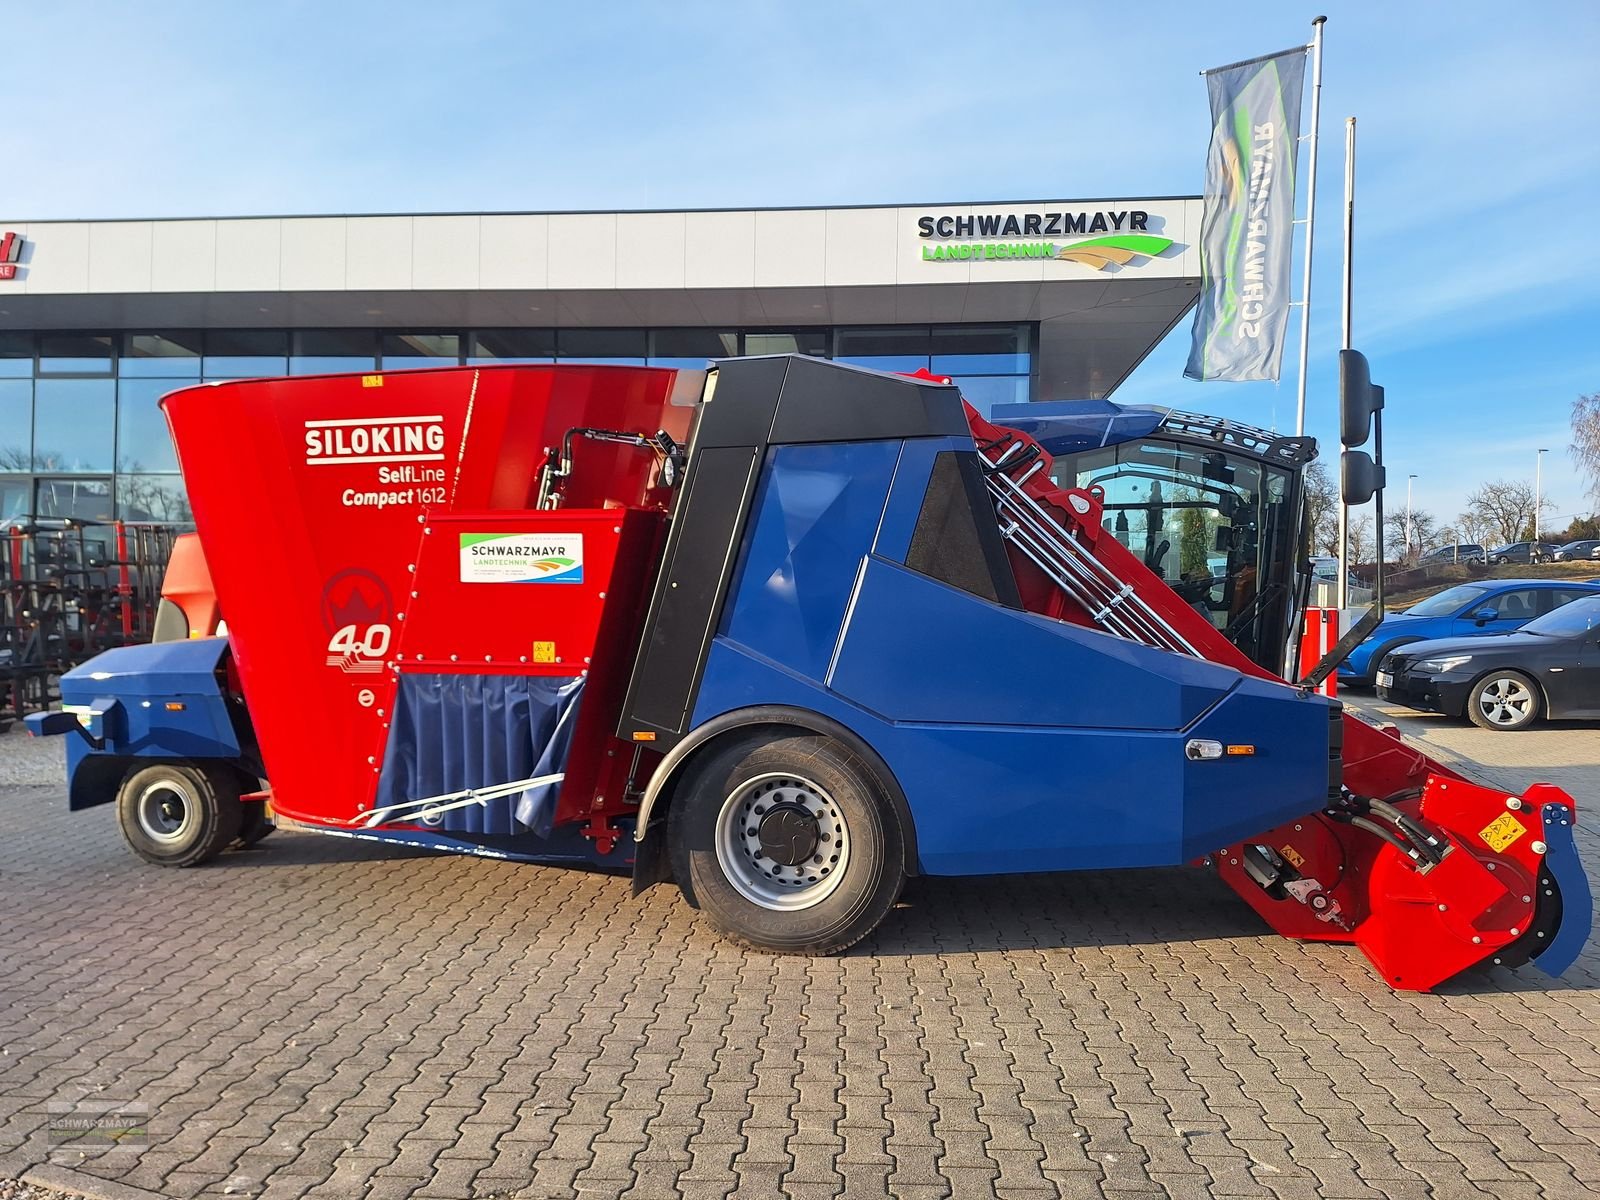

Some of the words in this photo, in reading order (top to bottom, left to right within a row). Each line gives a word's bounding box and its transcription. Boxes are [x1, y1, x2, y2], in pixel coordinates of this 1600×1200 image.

[918, 210, 1149, 238] SCHWARZMAYR
[922, 242, 1054, 261] LANDTECHNIK
[305, 425, 445, 456] SILOKING
[379, 465, 446, 484] SelfLine
[342, 488, 414, 510] Compact
[416, 487, 446, 504] 1612
[472, 546, 565, 556] SCHWARZMAYR
[327, 624, 391, 657] 4.0
